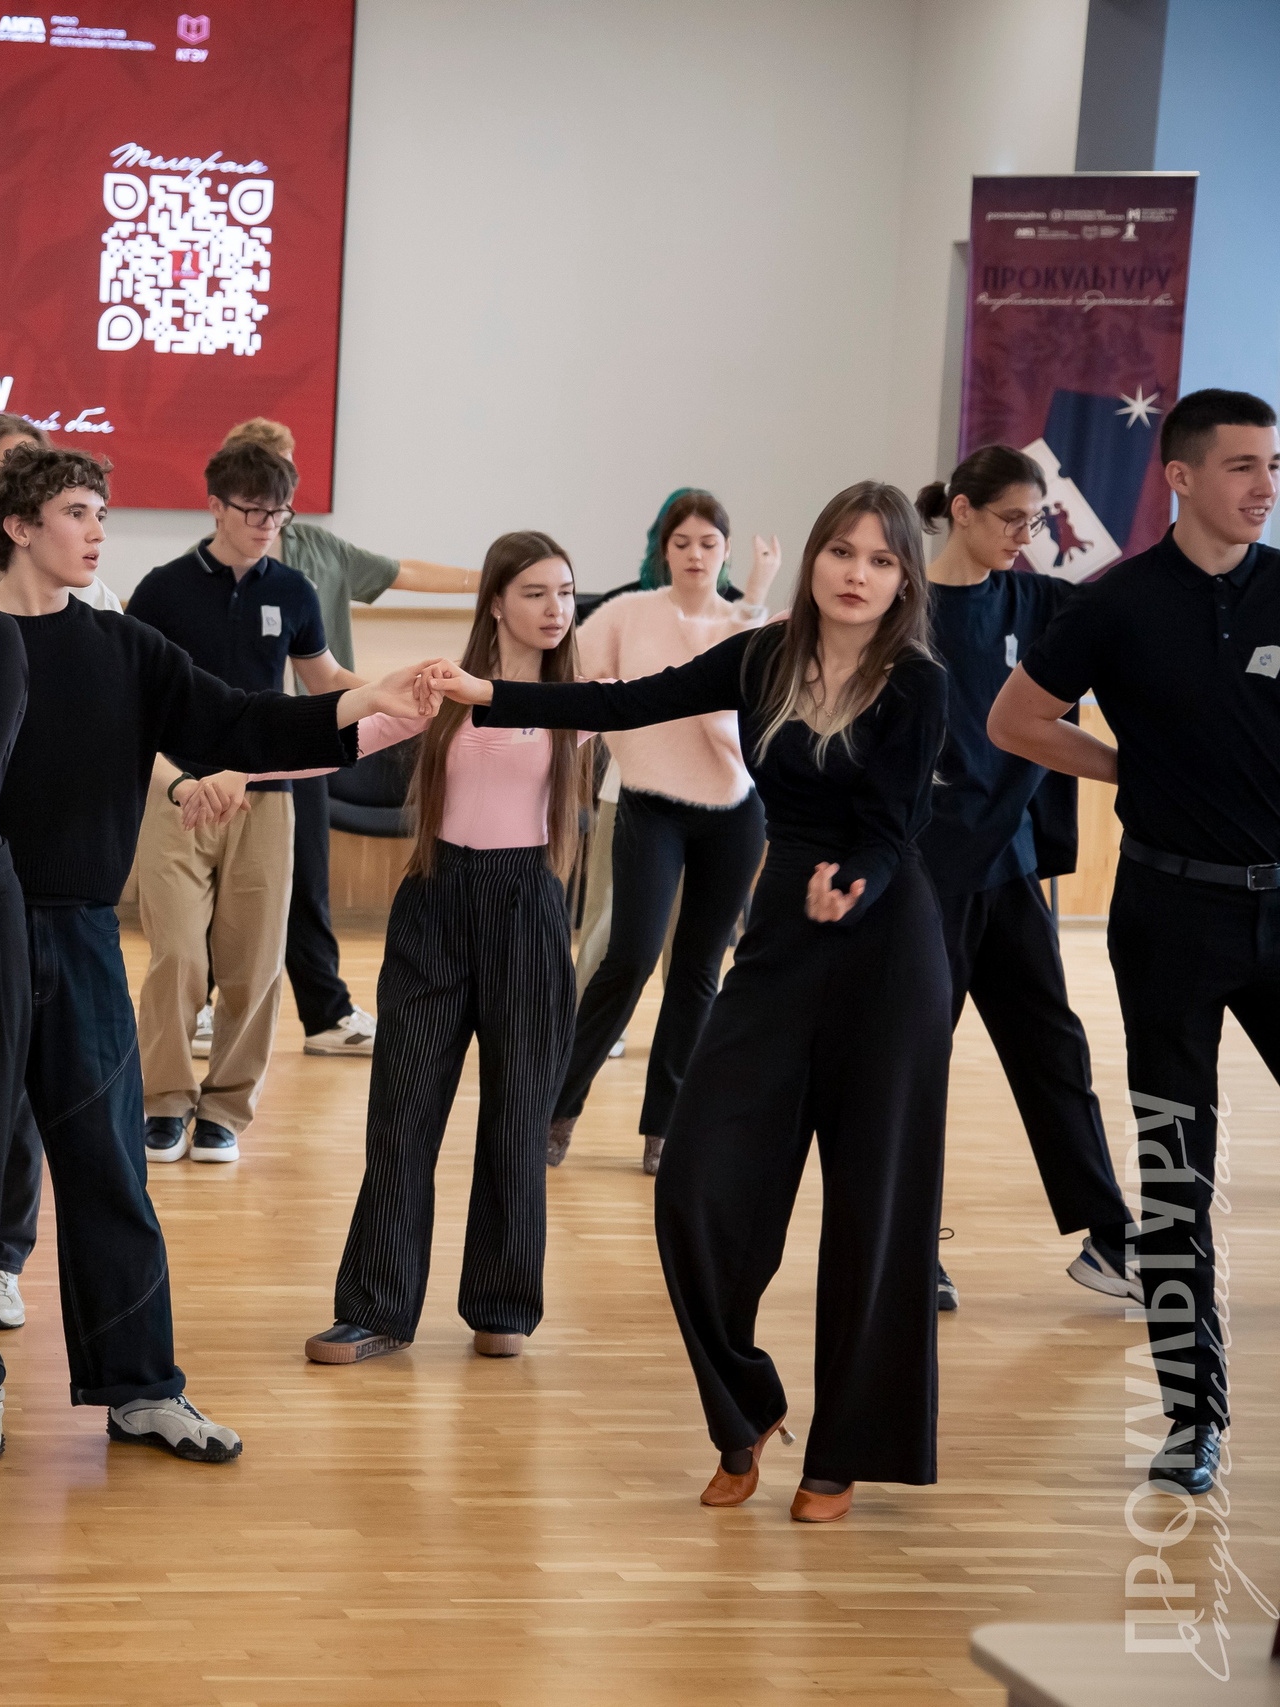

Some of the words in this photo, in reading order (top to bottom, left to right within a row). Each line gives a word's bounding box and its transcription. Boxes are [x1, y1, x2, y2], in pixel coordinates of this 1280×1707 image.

[983, 265, 1171, 290] ПРОКУЛЬТУРУ
[64, 406, 115, 434] бал
[355, 1337, 401, 1359] CATERPILL
